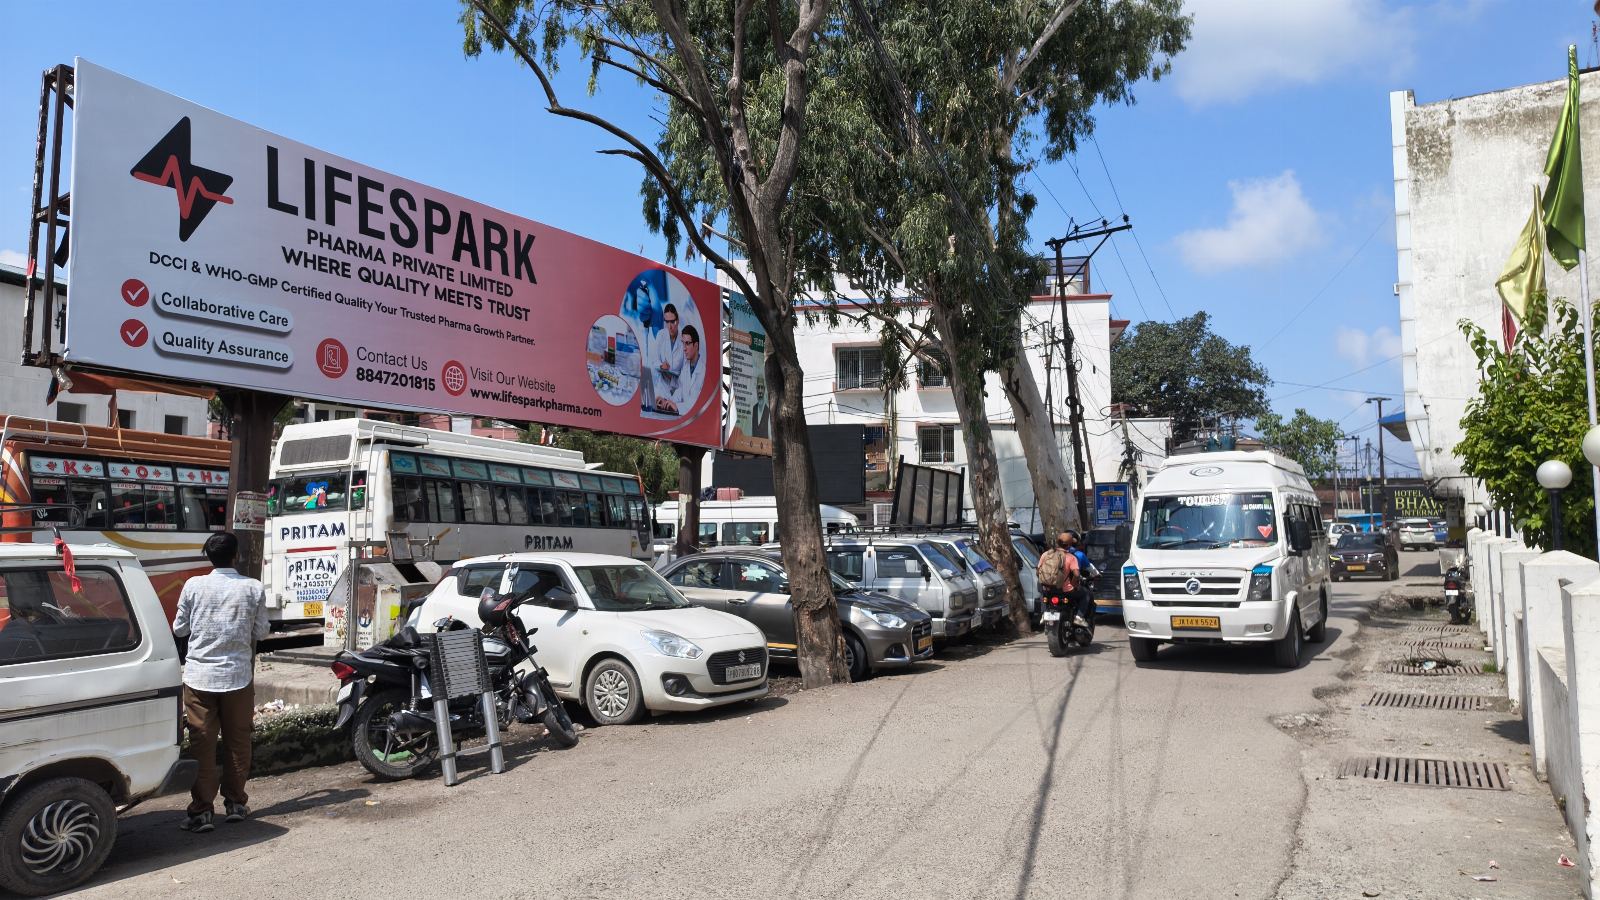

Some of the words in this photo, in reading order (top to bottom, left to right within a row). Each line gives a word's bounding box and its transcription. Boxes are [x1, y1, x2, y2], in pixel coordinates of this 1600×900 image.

[267, 145, 538, 284] LIFESPARK
[307, 228, 386, 264] PHARMA
[392, 252, 455, 282] PRIVATE
[460, 270, 513, 297] LIMITED
[281, 246, 351, 279] WHERE
[357, 266, 430, 297] QUALITY
[434, 285, 483, 310] MEETS
[487, 299, 531, 322] TRUST
[149, 252, 187, 271] DCCI
[191, 261, 202, 274] &
[205, 263, 278, 289] WHO-GMP
[281, 280, 332, 302] Certified
[334, 292, 374, 312] Quality
[375, 300, 397, 316] Your
[400, 306, 436, 324] Trusted
[438, 316, 472, 332] Pharma
[473, 324, 504, 340] Growth
[506, 331, 536, 346] Partner.
[161, 292, 255, 321] Collaborative
[259, 310, 289, 327] Care
[162, 331, 214, 355] Quality
[218, 340, 289, 363] Assurance
[357, 346, 407, 368] Contact
[411, 355, 428, 371] Us
[356, 367, 436, 392] 8847201815
[470, 366, 493, 383] Visit
[496, 371, 515, 387] Our
[518, 373, 556, 393] Website
[470, 389, 602, 417] www.lifesparkpharma.com
[63, 460, 78, 475] K
[135, 465, 148, 480] O
[200, 471, 213, 483] H
[281, 522, 346, 540] PRITAM
[525, 534, 574, 550] PRITAM
[288, 558, 337, 578] PRITAM
